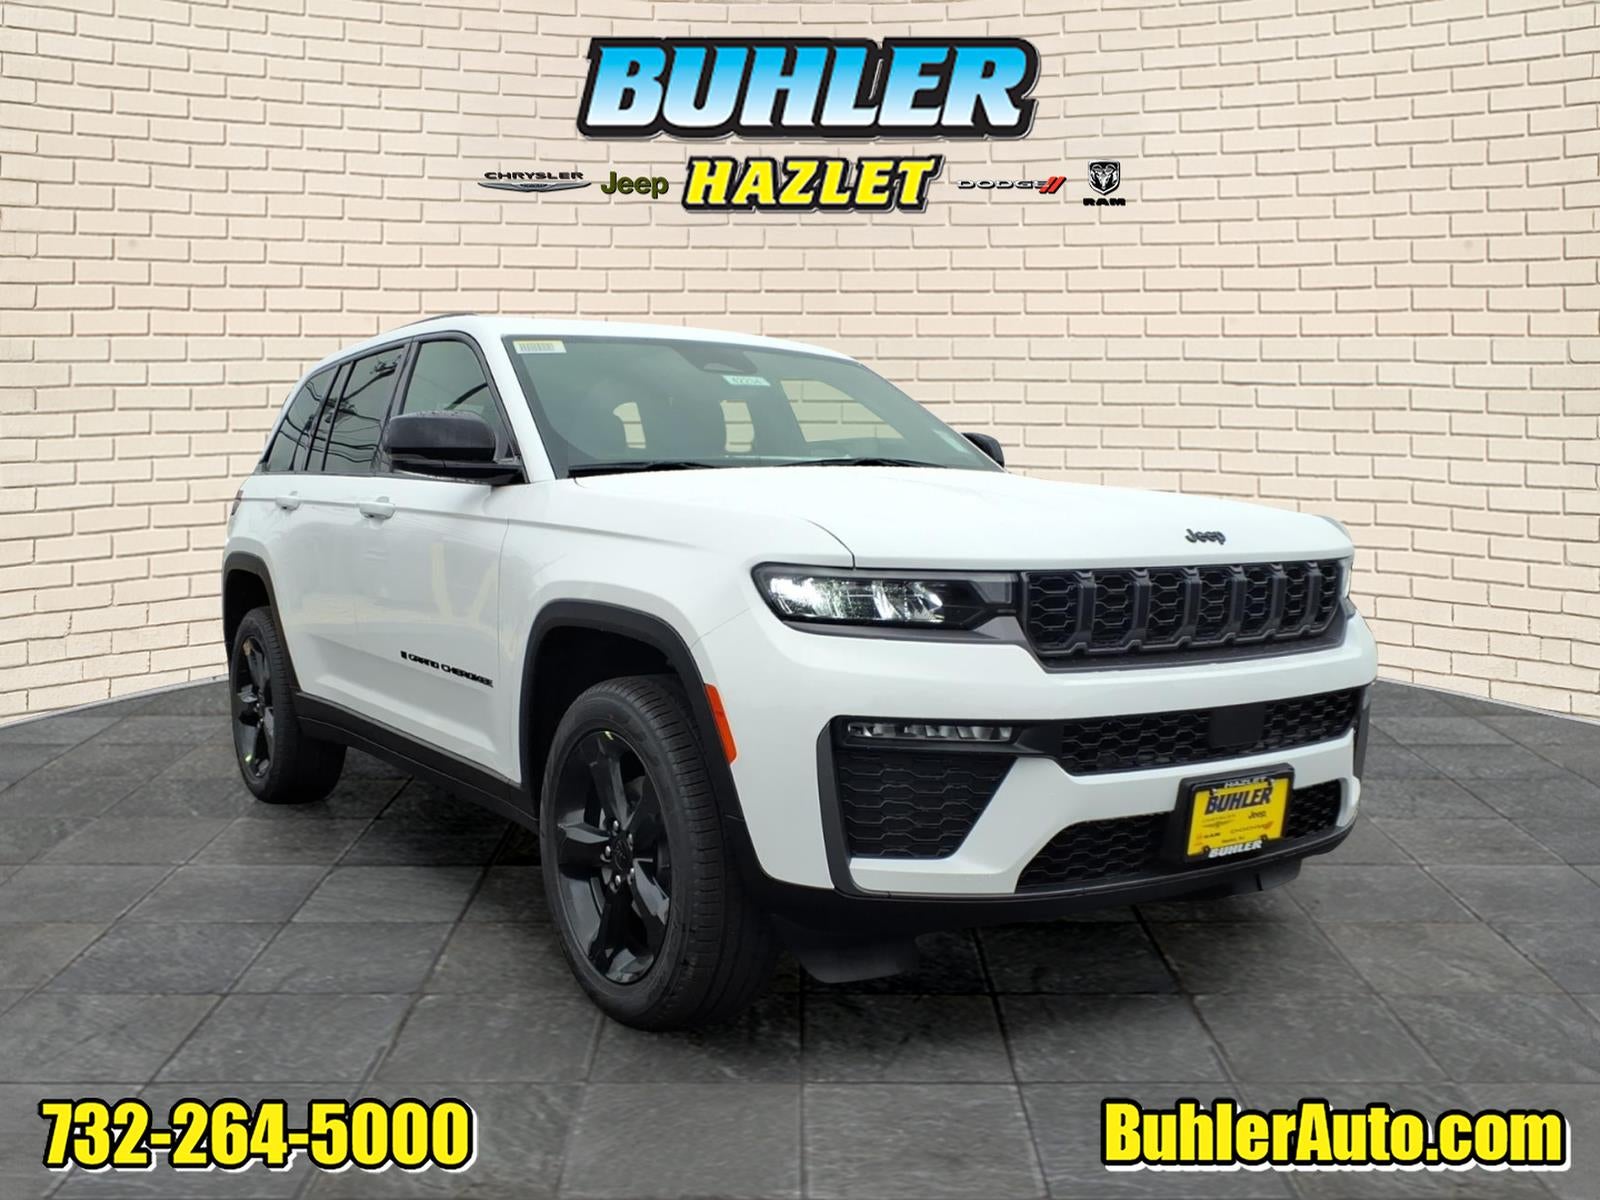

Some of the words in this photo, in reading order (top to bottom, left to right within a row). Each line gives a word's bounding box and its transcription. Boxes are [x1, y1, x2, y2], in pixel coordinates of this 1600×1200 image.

[1185, 527, 1227, 546] Jeep
[408, 653, 440, 670] GRAND
[441, 663, 494, 688] CHEROKEE
[1204, 787, 1272, 814] BUHLER
[1208, 839, 1263, 858] BUHLER
